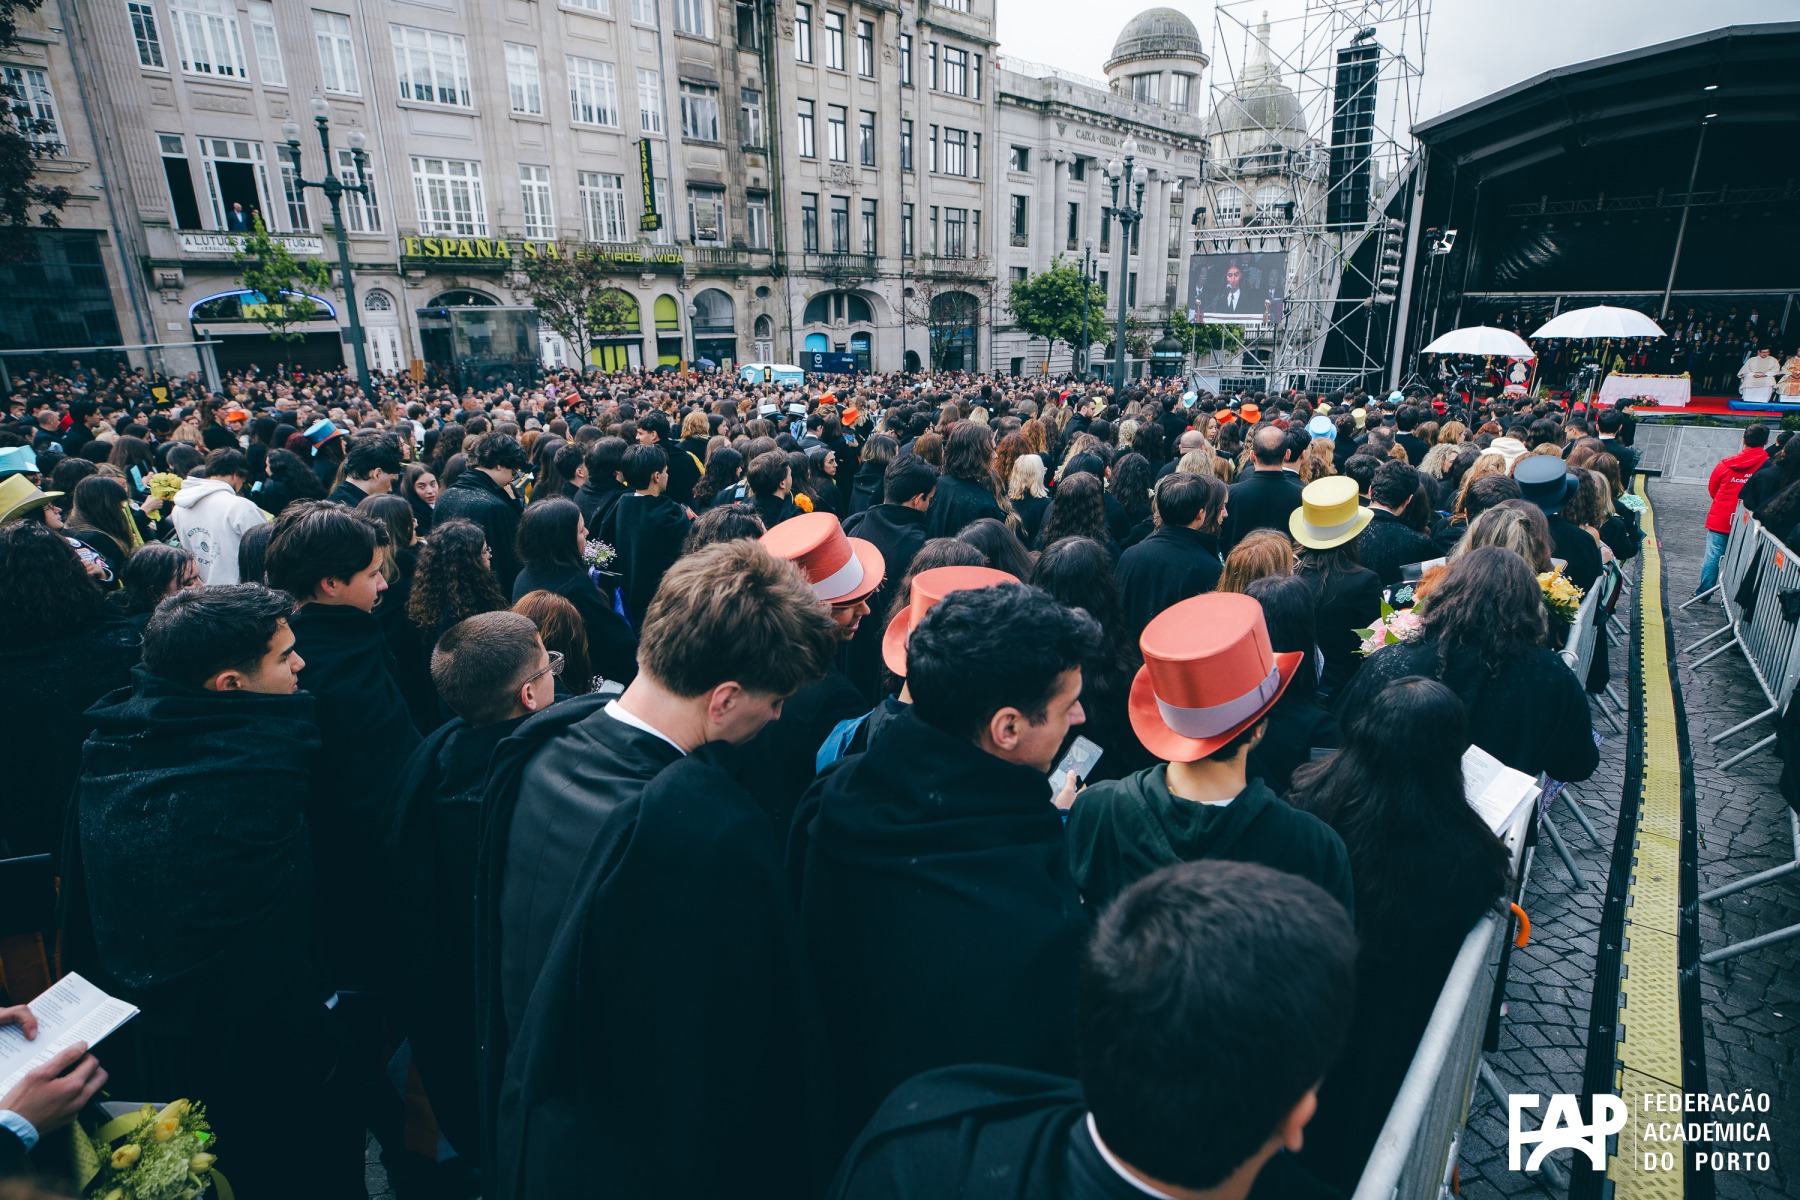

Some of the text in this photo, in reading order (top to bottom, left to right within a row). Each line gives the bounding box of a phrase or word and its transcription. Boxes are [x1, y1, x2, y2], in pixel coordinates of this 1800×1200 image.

[1075, 129, 1096, 142] CAIXA
[1099, 135, 1117, 147] GERAL
[404, 237, 511, 258] ESPAÑA
[655, 253, 685, 264] VIDA
